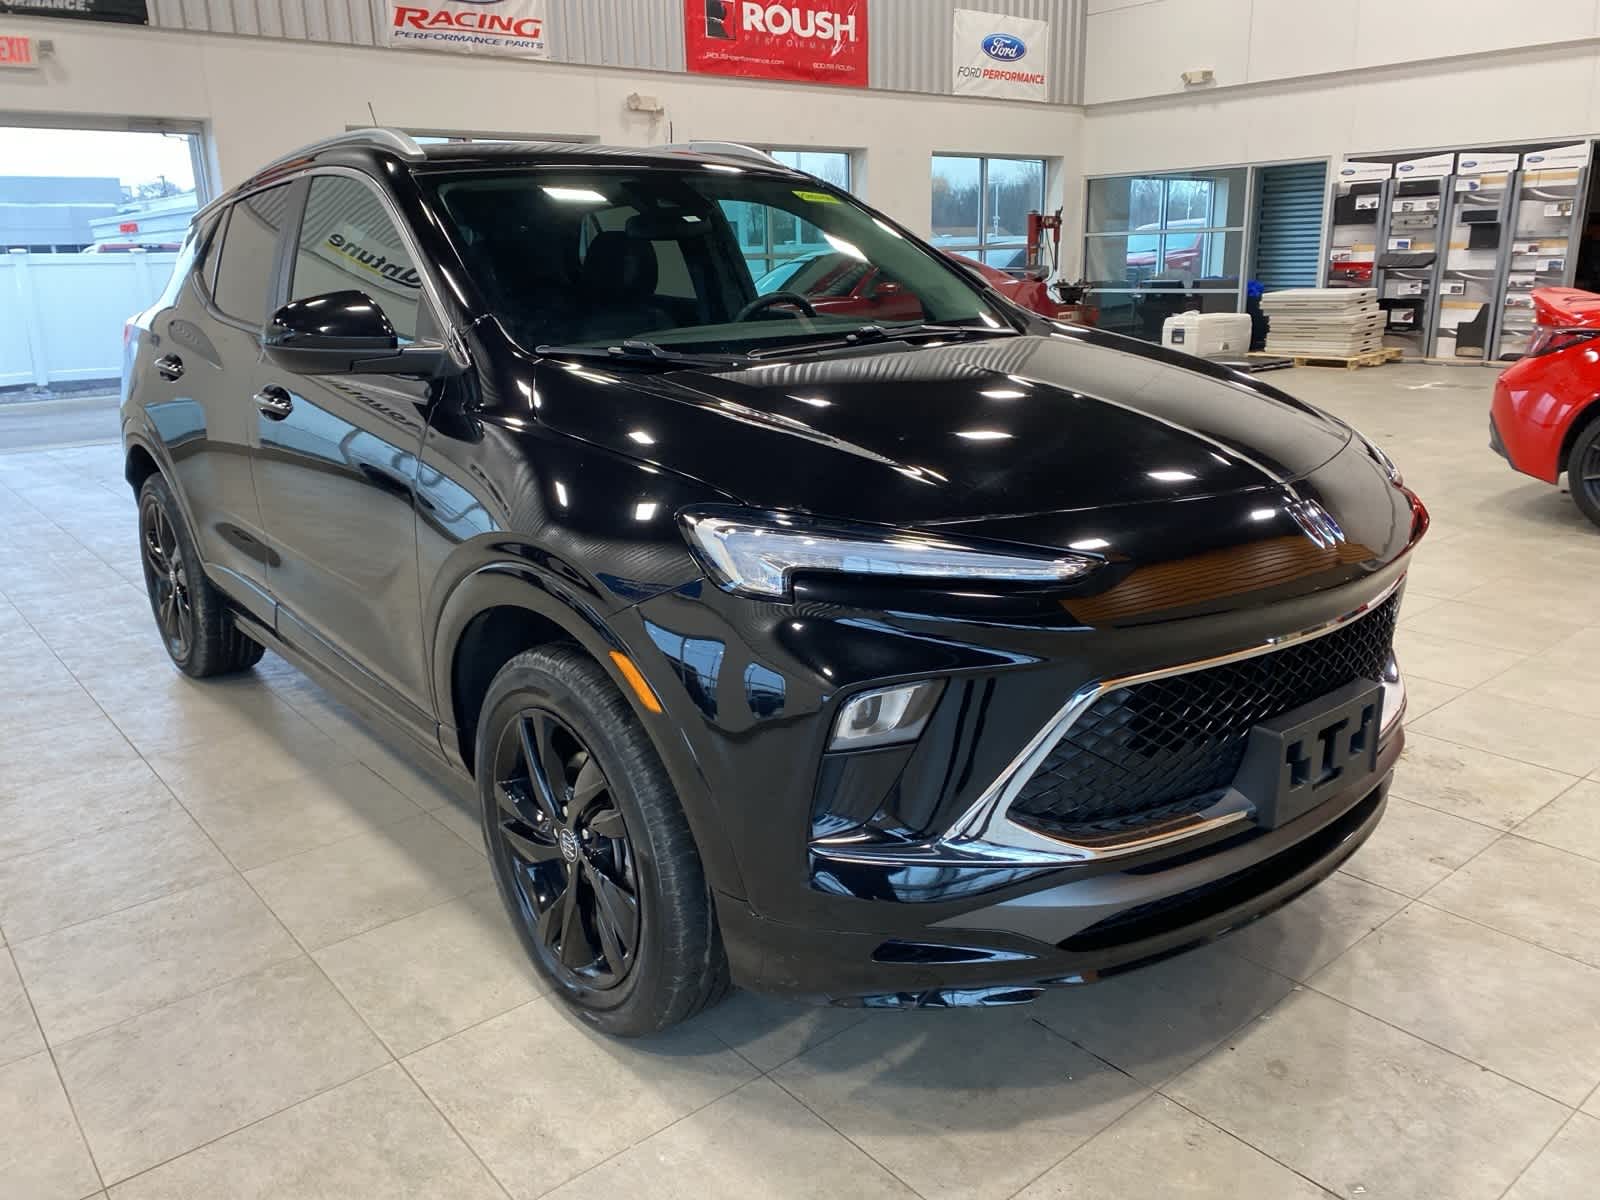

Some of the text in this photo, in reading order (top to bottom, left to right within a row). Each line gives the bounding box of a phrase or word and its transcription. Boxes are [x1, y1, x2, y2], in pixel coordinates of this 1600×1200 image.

[393, 6, 543, 39] RACING
[742, 1, 856, 42] ROUSH
[394, 30, 544, 49] PERFORMANCE PARTS
[744, 33, 856, 55] PERFORMACE
[989, 38, 1019, 58] Ford
[957, 66, 1045, 85] FORD PERFORMANCE
